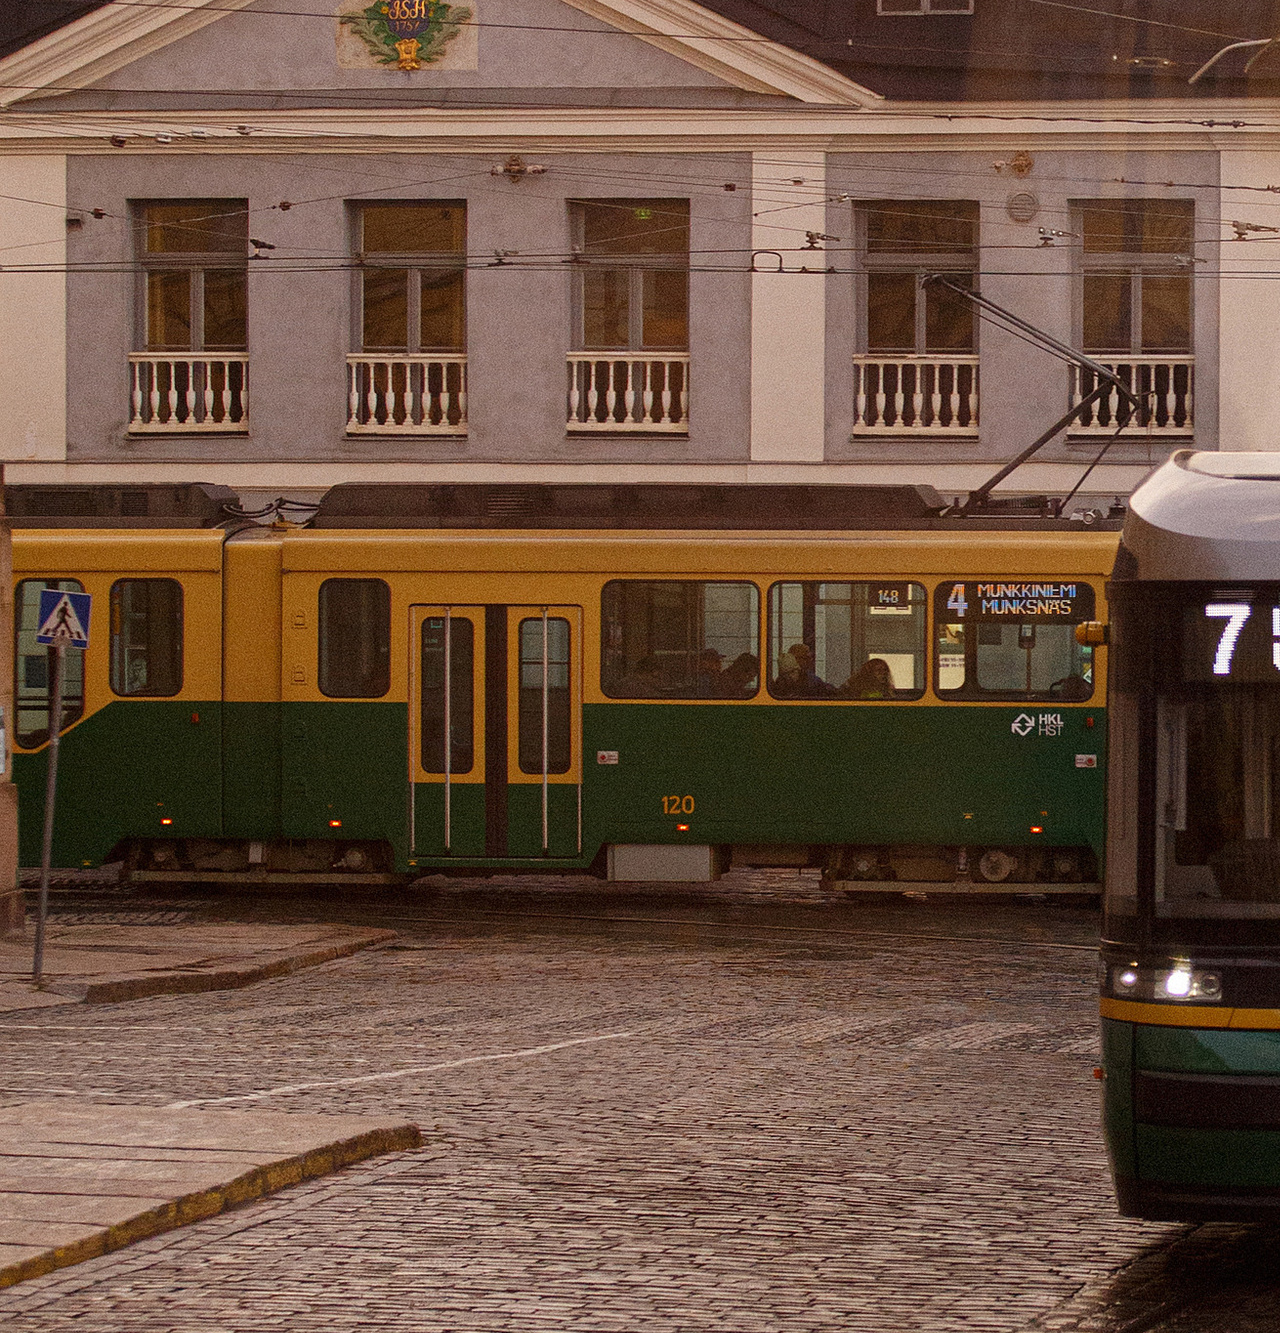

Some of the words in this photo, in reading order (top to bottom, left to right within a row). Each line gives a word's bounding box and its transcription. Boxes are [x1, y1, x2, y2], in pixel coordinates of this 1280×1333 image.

[878, 589, 899, 604] 148
[947, 584, 968, 616] 4
[977, 584, 1076, 598] MUNKKINIEMI
[982, 599, 1072, 615] MUNKSNÄS
[1205, 603, 1252, 676] 7
[1038, 714, 1064, 725] HKL
[1038, 725, 1064, 736] HST
[661, 795, 695, 814] 120
